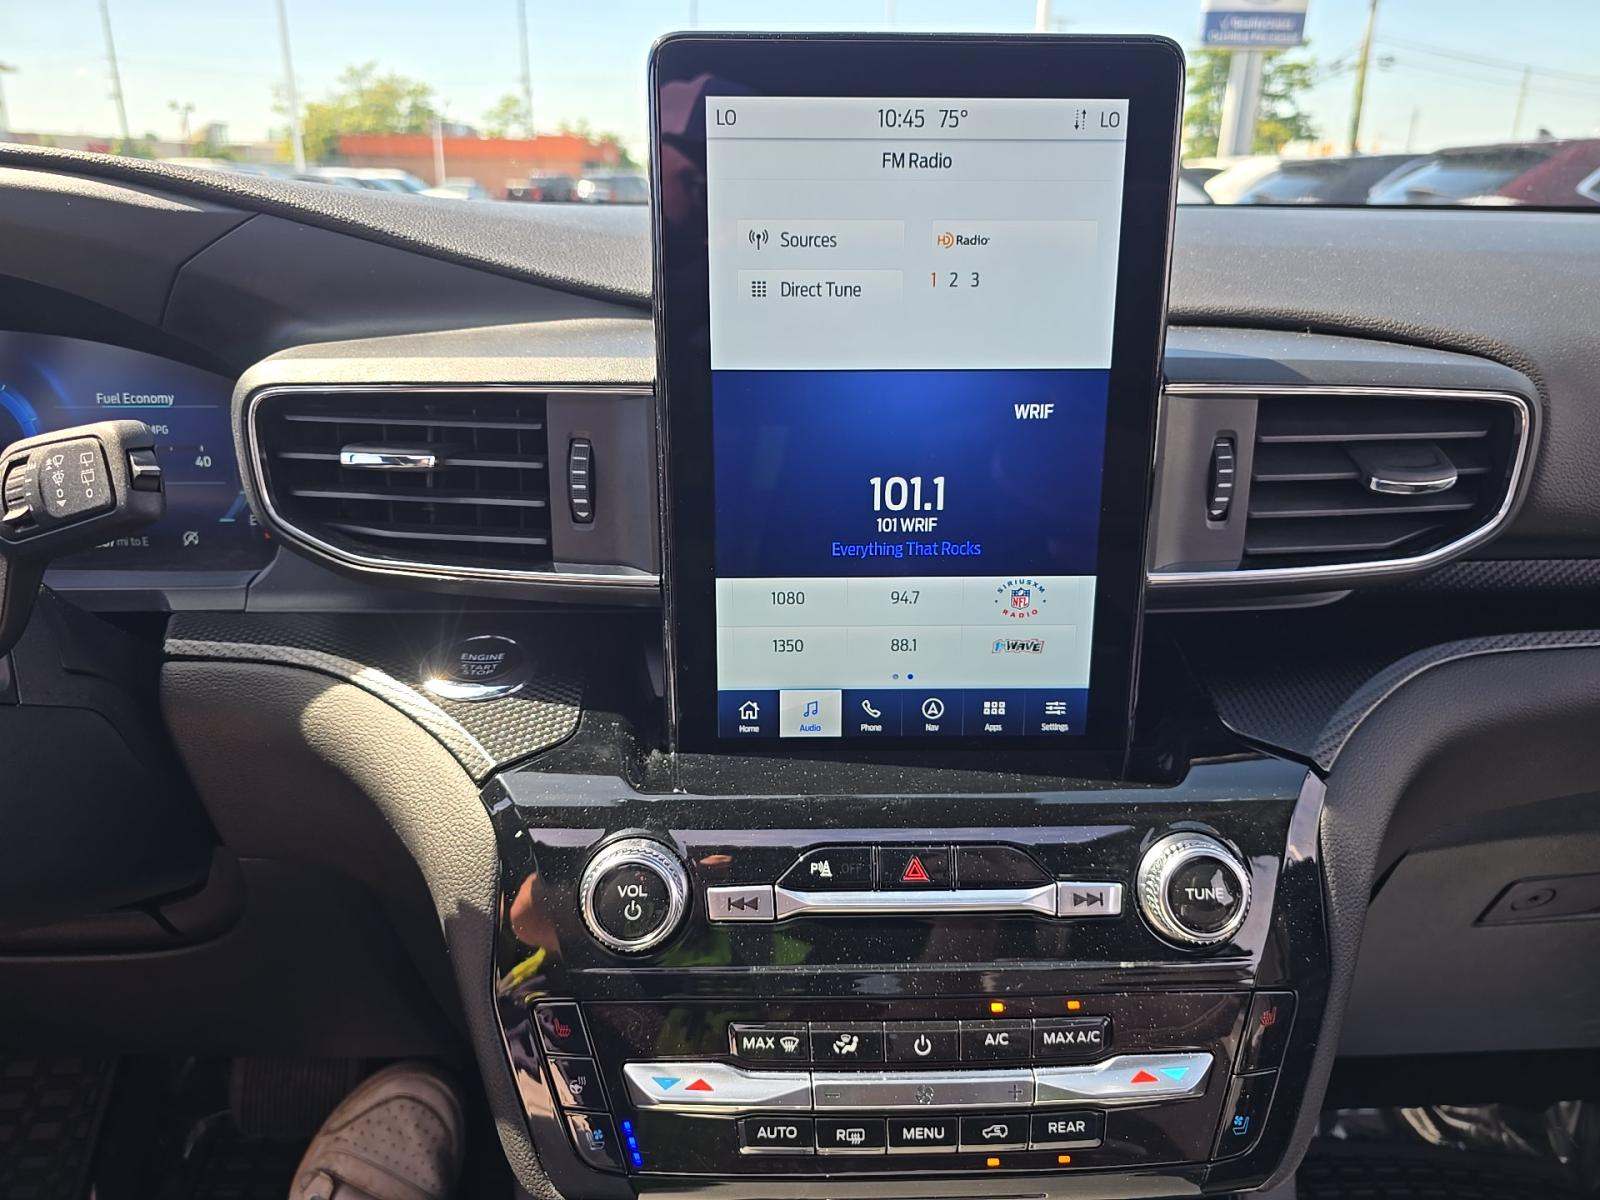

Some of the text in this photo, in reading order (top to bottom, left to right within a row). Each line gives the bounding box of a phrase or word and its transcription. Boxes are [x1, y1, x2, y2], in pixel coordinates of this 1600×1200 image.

[716, 109, 737, 126] LO
[877, 108, 969, 129] 10:45 75°
[1100, 111, 1120, 128] LO
[881, 151, 952, 169] FM Radio
[780, 230, 837, 249] Sources
[955, 234, 990, 247] Radio
[930, 272, 980, 288] 1 2 3
[780, 280, 862, 299] Direct Tune
[96, 393, 175, 407] Fuel Economy
[1013, 403, 1055, 420] WRIF
[195, 456, 212, 468] 40
[869, 476, 945, 511] 101.1
[876, 517, 938, 533] 101 WRIF
[142, 536, 150, 547] E
[831, 540, 981, 559] Everything That Rocks
[997, 579, 1045, 594] SIRIUSXM
[771, 591, 805, 606] 1080
[890, 590, 920, 606] 94.7
[1012, 597, 1029, 608] NFL
[1002, 609, 1038, 618] RADIO
[772, 638, 804, 653] 1350
[890, 638, 918, 653] 88.1
[460, 652, 505, 661] ENGINE
[738, 723, 760, 734] Home
[799, 722, 822, 733] Audio
[860, 722, 882, 733] Phone
[925, 722, 940, 733] Nav
[984, 722, 1003, 736] Apps
[1041, 722, 1068, 735] Settings
[617, 885, 648, 898] VOL
[1184, 887, 1225, 901] TUNE
[742, 1037, 776, 1050] MAX
[984, 1033, 1009, 1047] A/C
[1043, 1032, 1101, 1045] MAX A/C
[757, 1126, 798, 1140] AUTO
[902, 1126, 945, 1140] MENU
[1048, 1120, 1086, 1134] REAR
